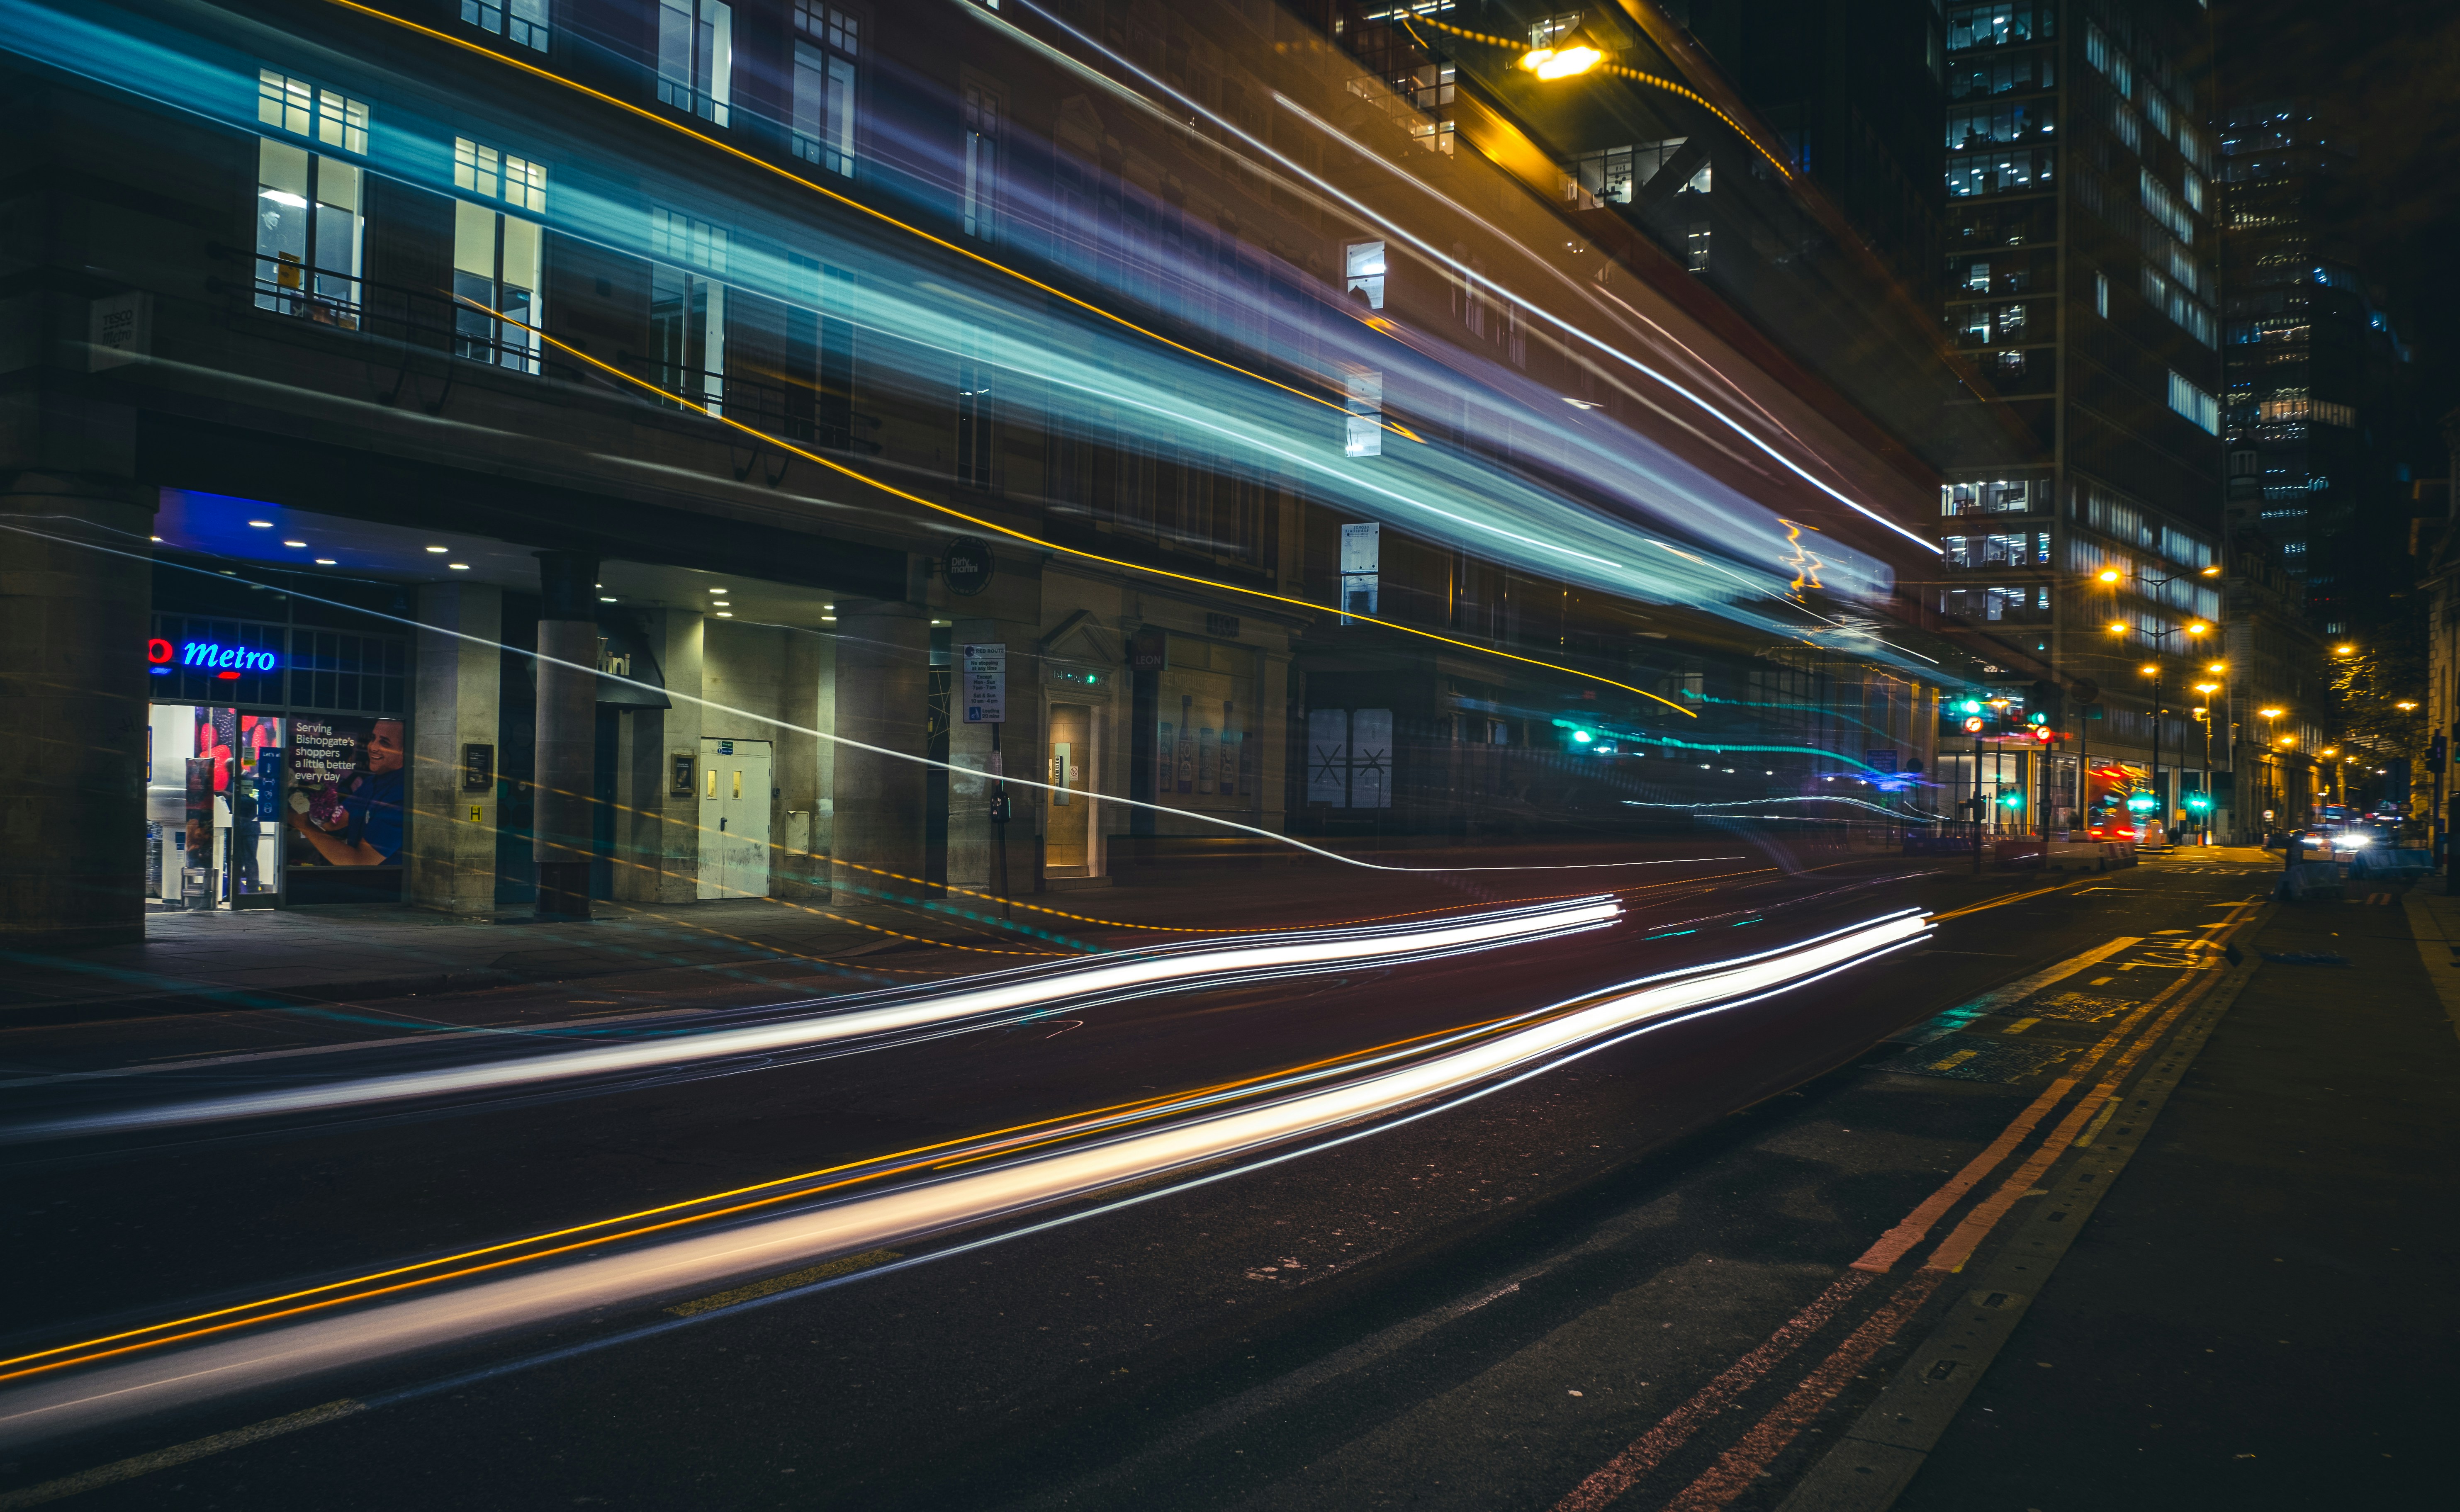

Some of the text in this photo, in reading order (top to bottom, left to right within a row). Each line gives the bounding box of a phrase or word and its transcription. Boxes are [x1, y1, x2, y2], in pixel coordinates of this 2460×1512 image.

[103, 310, 132, 326] TESCO
[103, 330, 131, 345] Metro
[951, 557, 970, 567] Dirty
[951, 563, 978, 573] martini
[184, 642, 275, 670] Metro
[1136, 655, 1161, 665] LEON
[296, 722, 332, 735] Serving
[296, 734, 355, 747] Bishopgate's
[296, 746, 341, 758] shoppers
[303, 759, 324, 768] little
[326, 760, 356, 770] better
[295, 771, 341, 783] every day
